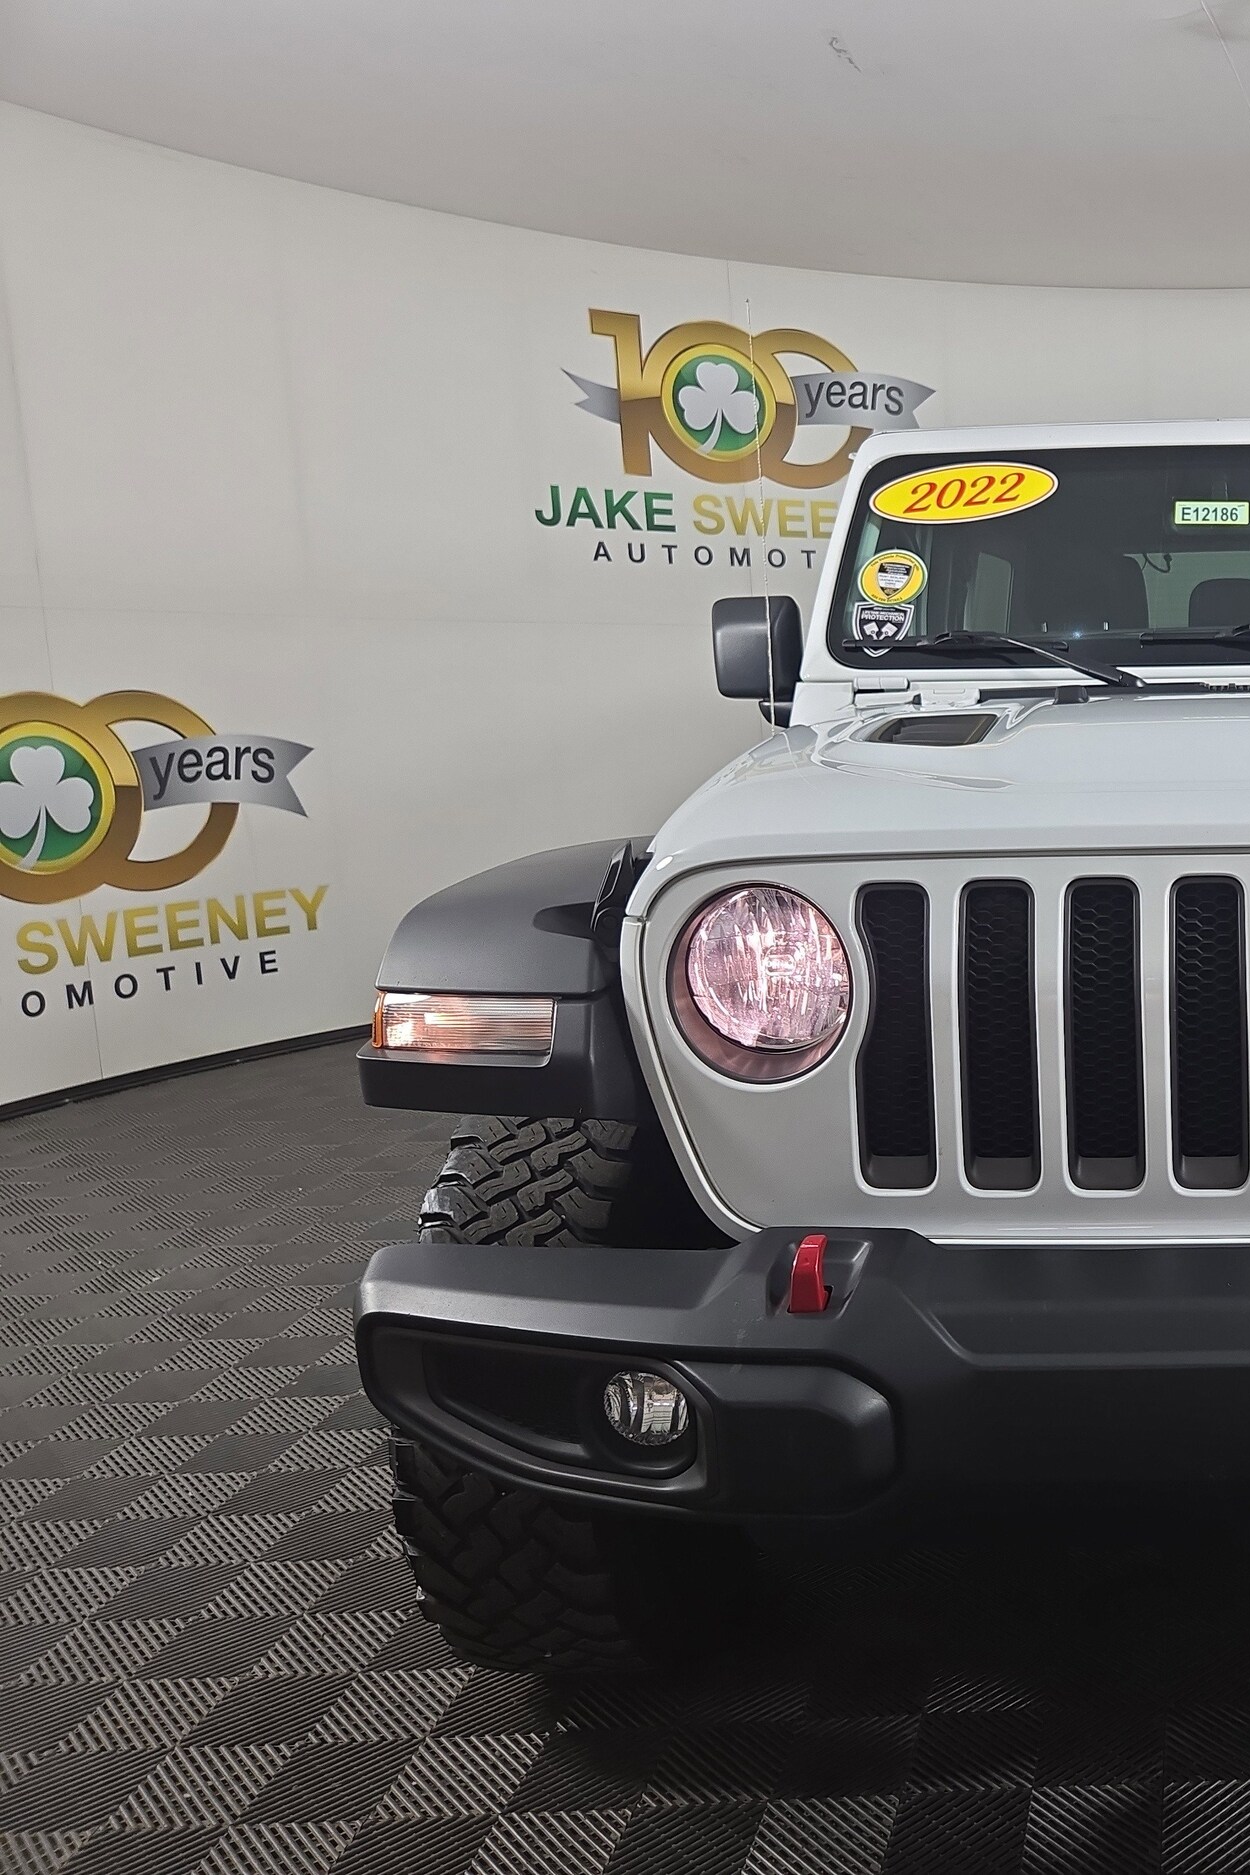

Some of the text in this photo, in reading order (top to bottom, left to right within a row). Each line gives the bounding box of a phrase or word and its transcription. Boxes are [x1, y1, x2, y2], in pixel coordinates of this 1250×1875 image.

[804, 380, 905, 418] years
[534, 485, 838, 539] JAKE SWEE
[903, 472, 1025, 514] 2022
[1182, 507, 1238, 521] E12186
[593, 541, 816, 570] AUTOMOT
[0, 690, 239, 904] 00
[150, 746, 275, 800] years
[16, 885, 329, 975] SWEENEY
[20, 950, 279, 1017] OMOTIVE
